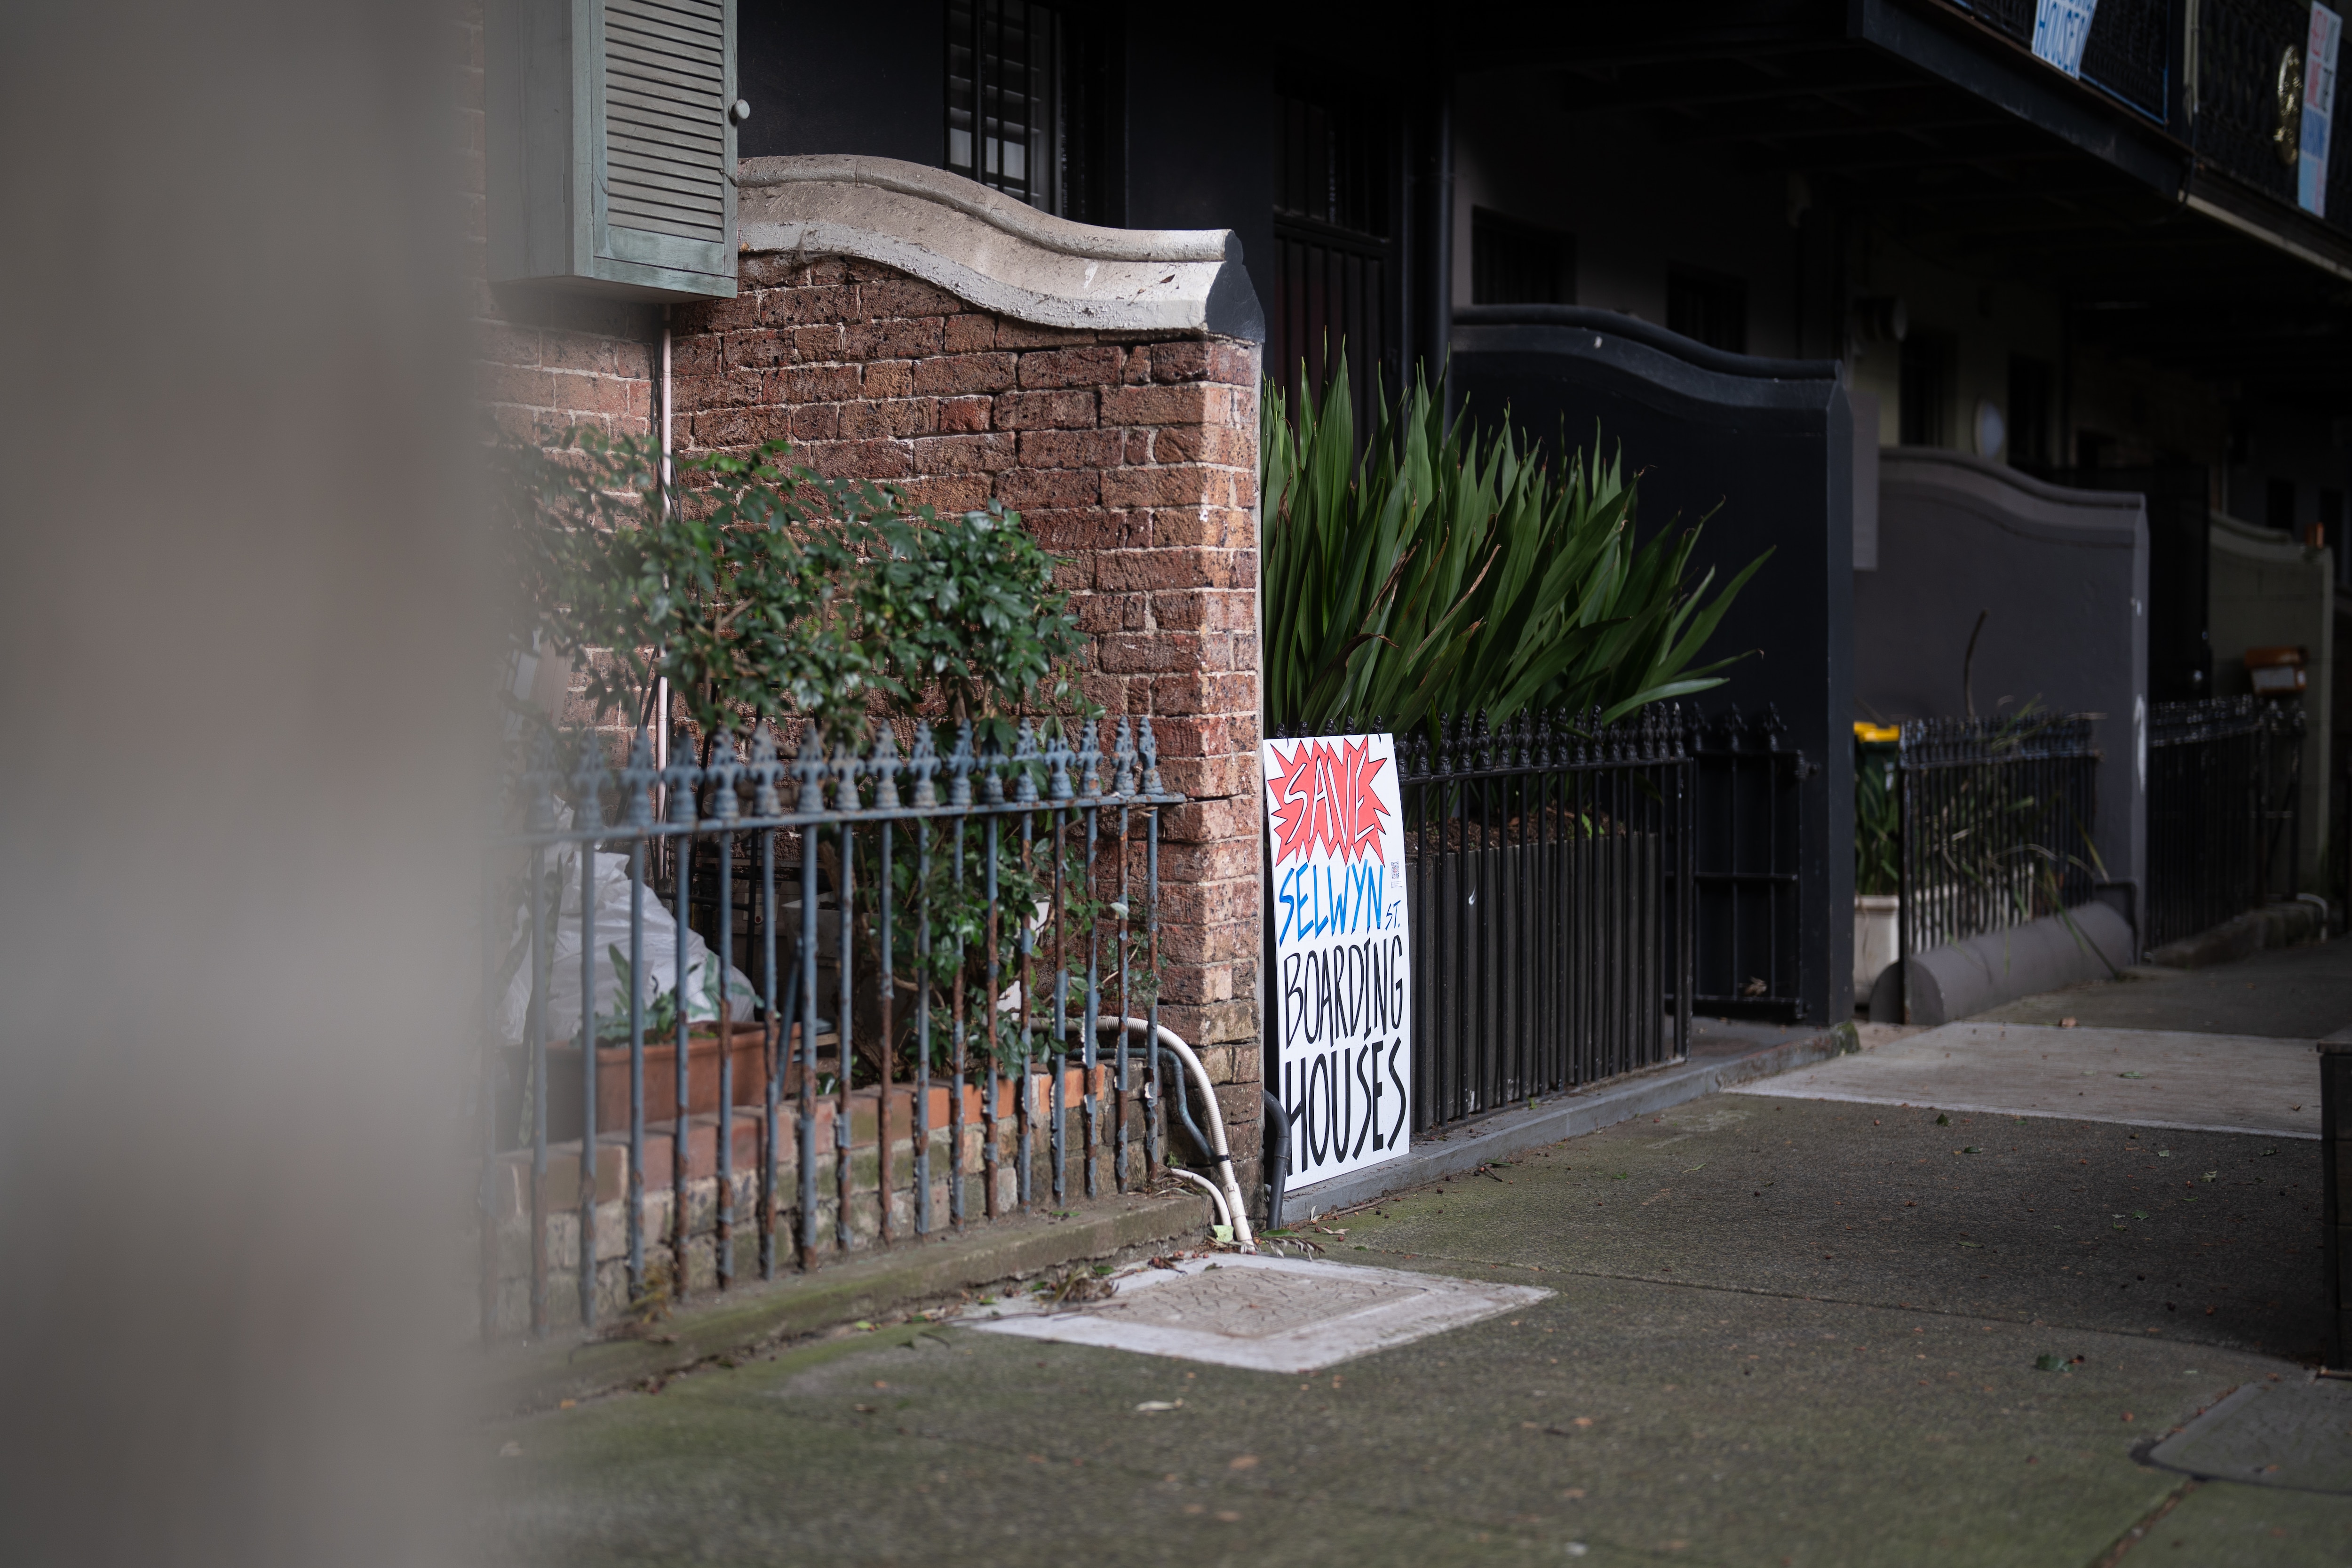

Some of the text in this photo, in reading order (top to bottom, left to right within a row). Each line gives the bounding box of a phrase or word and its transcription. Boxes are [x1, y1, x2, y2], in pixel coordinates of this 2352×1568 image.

[1283, 746, 1375, 850] SAVE
[1279, 859, 1401, 948] SELWYN ST.
[1284, 935, 1403, 1049] BOARDING
[1285, 1036, 1406, 1177] HOUSES
